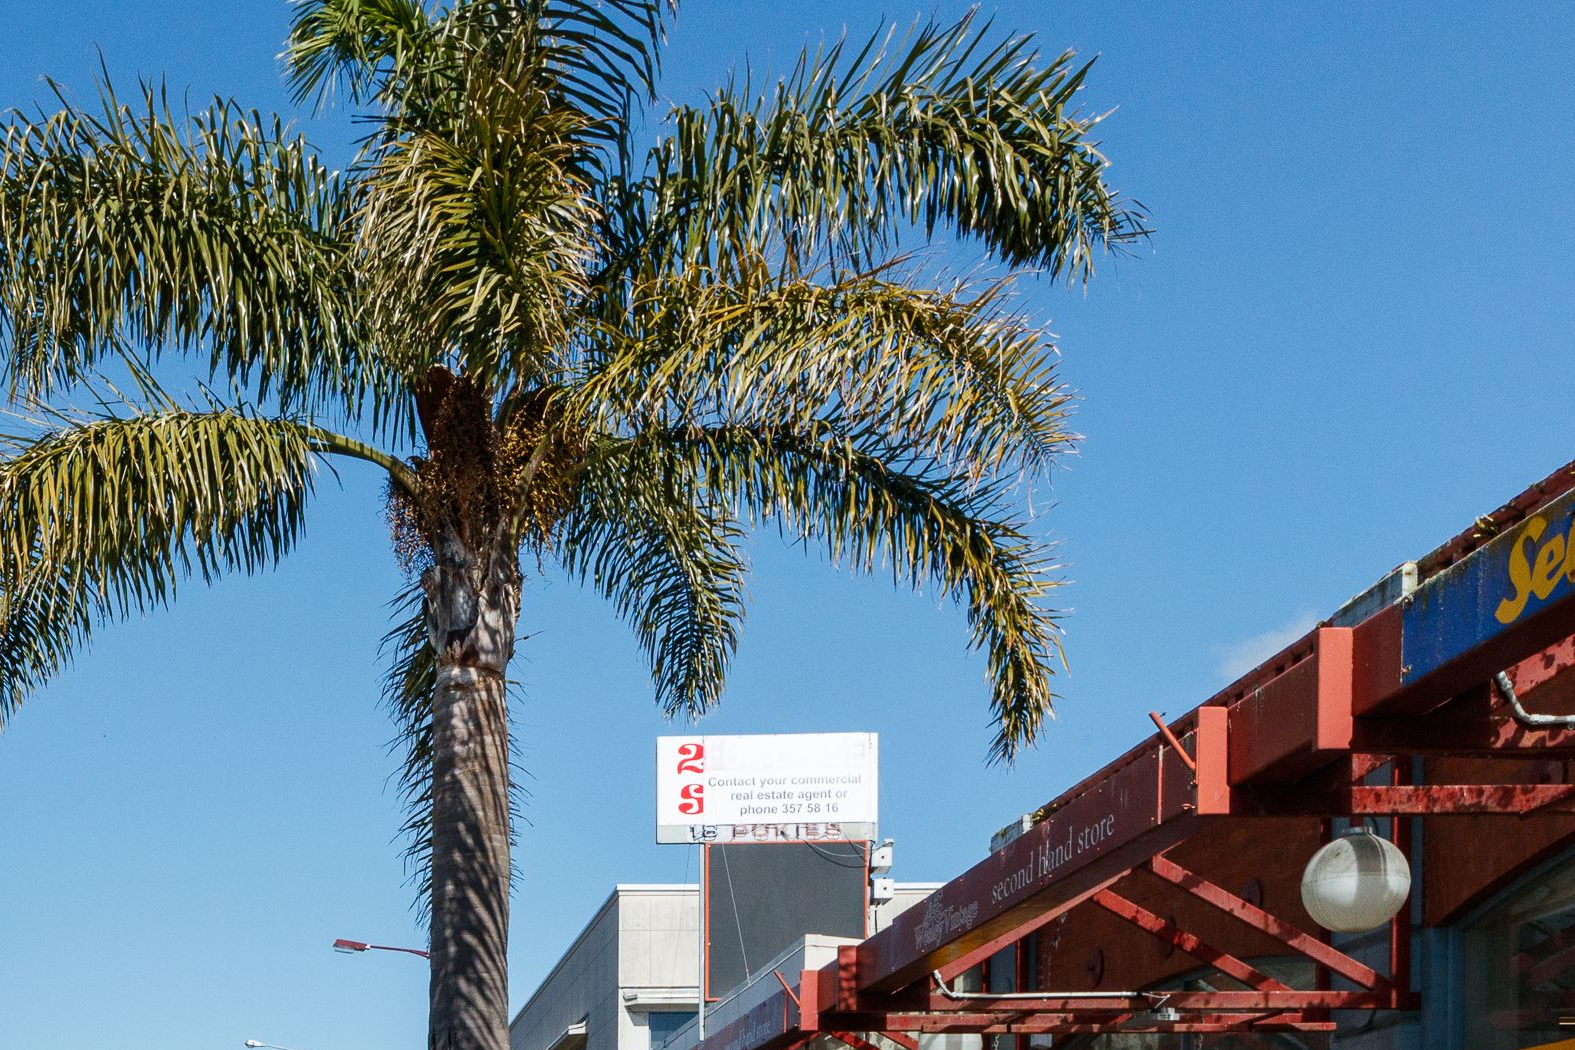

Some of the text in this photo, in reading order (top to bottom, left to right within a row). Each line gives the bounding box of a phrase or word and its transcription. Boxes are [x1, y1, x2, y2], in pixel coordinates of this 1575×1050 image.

[1494, 515, 1575, 624] Se
[708, 774, 862, 788] Contact your commercial
[730, 790, 848, 801] real estate agent or
[740, 802, 839, 816] phone 357 58 16
[991, 813, 1115, 904] second hand store
